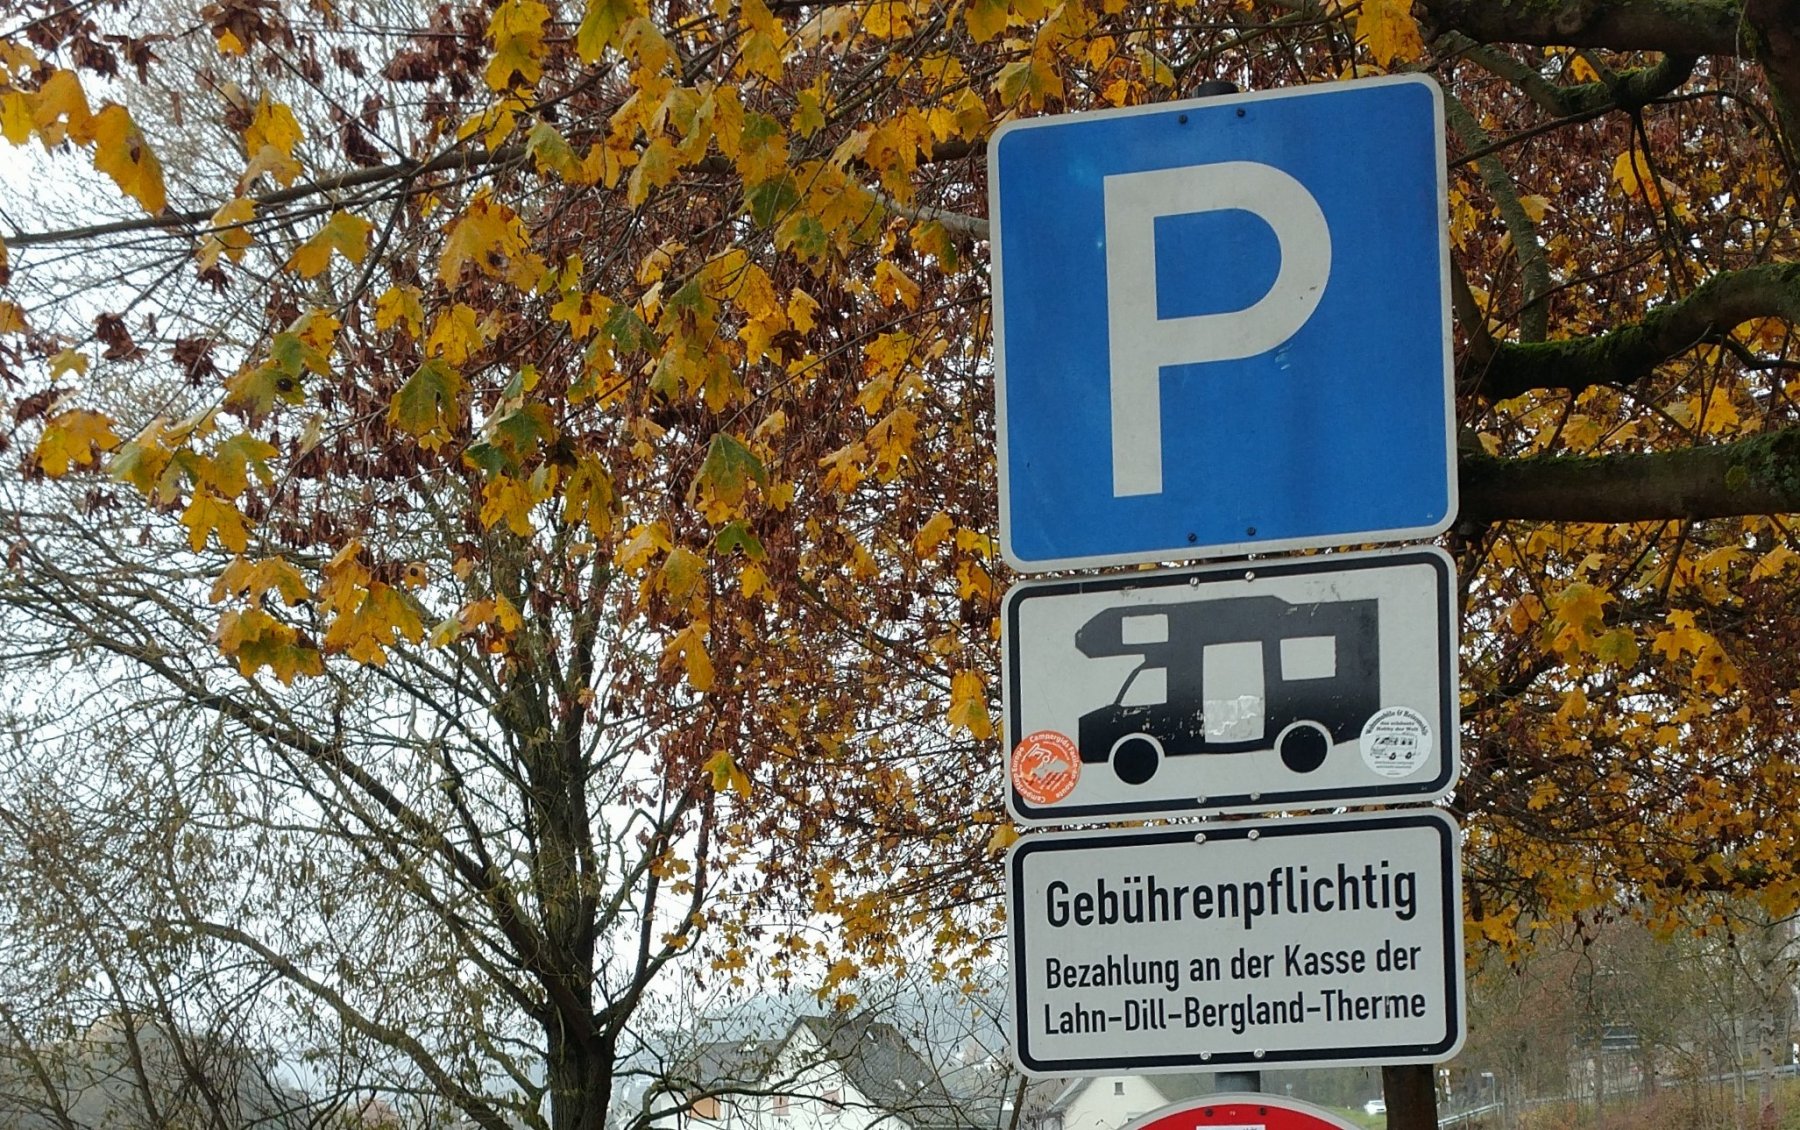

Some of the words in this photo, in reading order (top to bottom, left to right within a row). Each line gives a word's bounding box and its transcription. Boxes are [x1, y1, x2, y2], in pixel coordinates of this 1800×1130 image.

[1103, 160, 1333, 498] P
[1011, 746, 1025, 773] Europe
[1046, 860, 1417, 931] Gebührenpflichtig
[1045, 953, 1180, 992] Bezahlung
[1189, 957, 1221, 982] an
[1230, 947, 1275, 980] der
[1284, 944, 1366, 977] Kasse
[1376, 939, 1422, 972] der
[1044, 988, 1426, 1035] Lahn-Dill-Bergland-Therme
